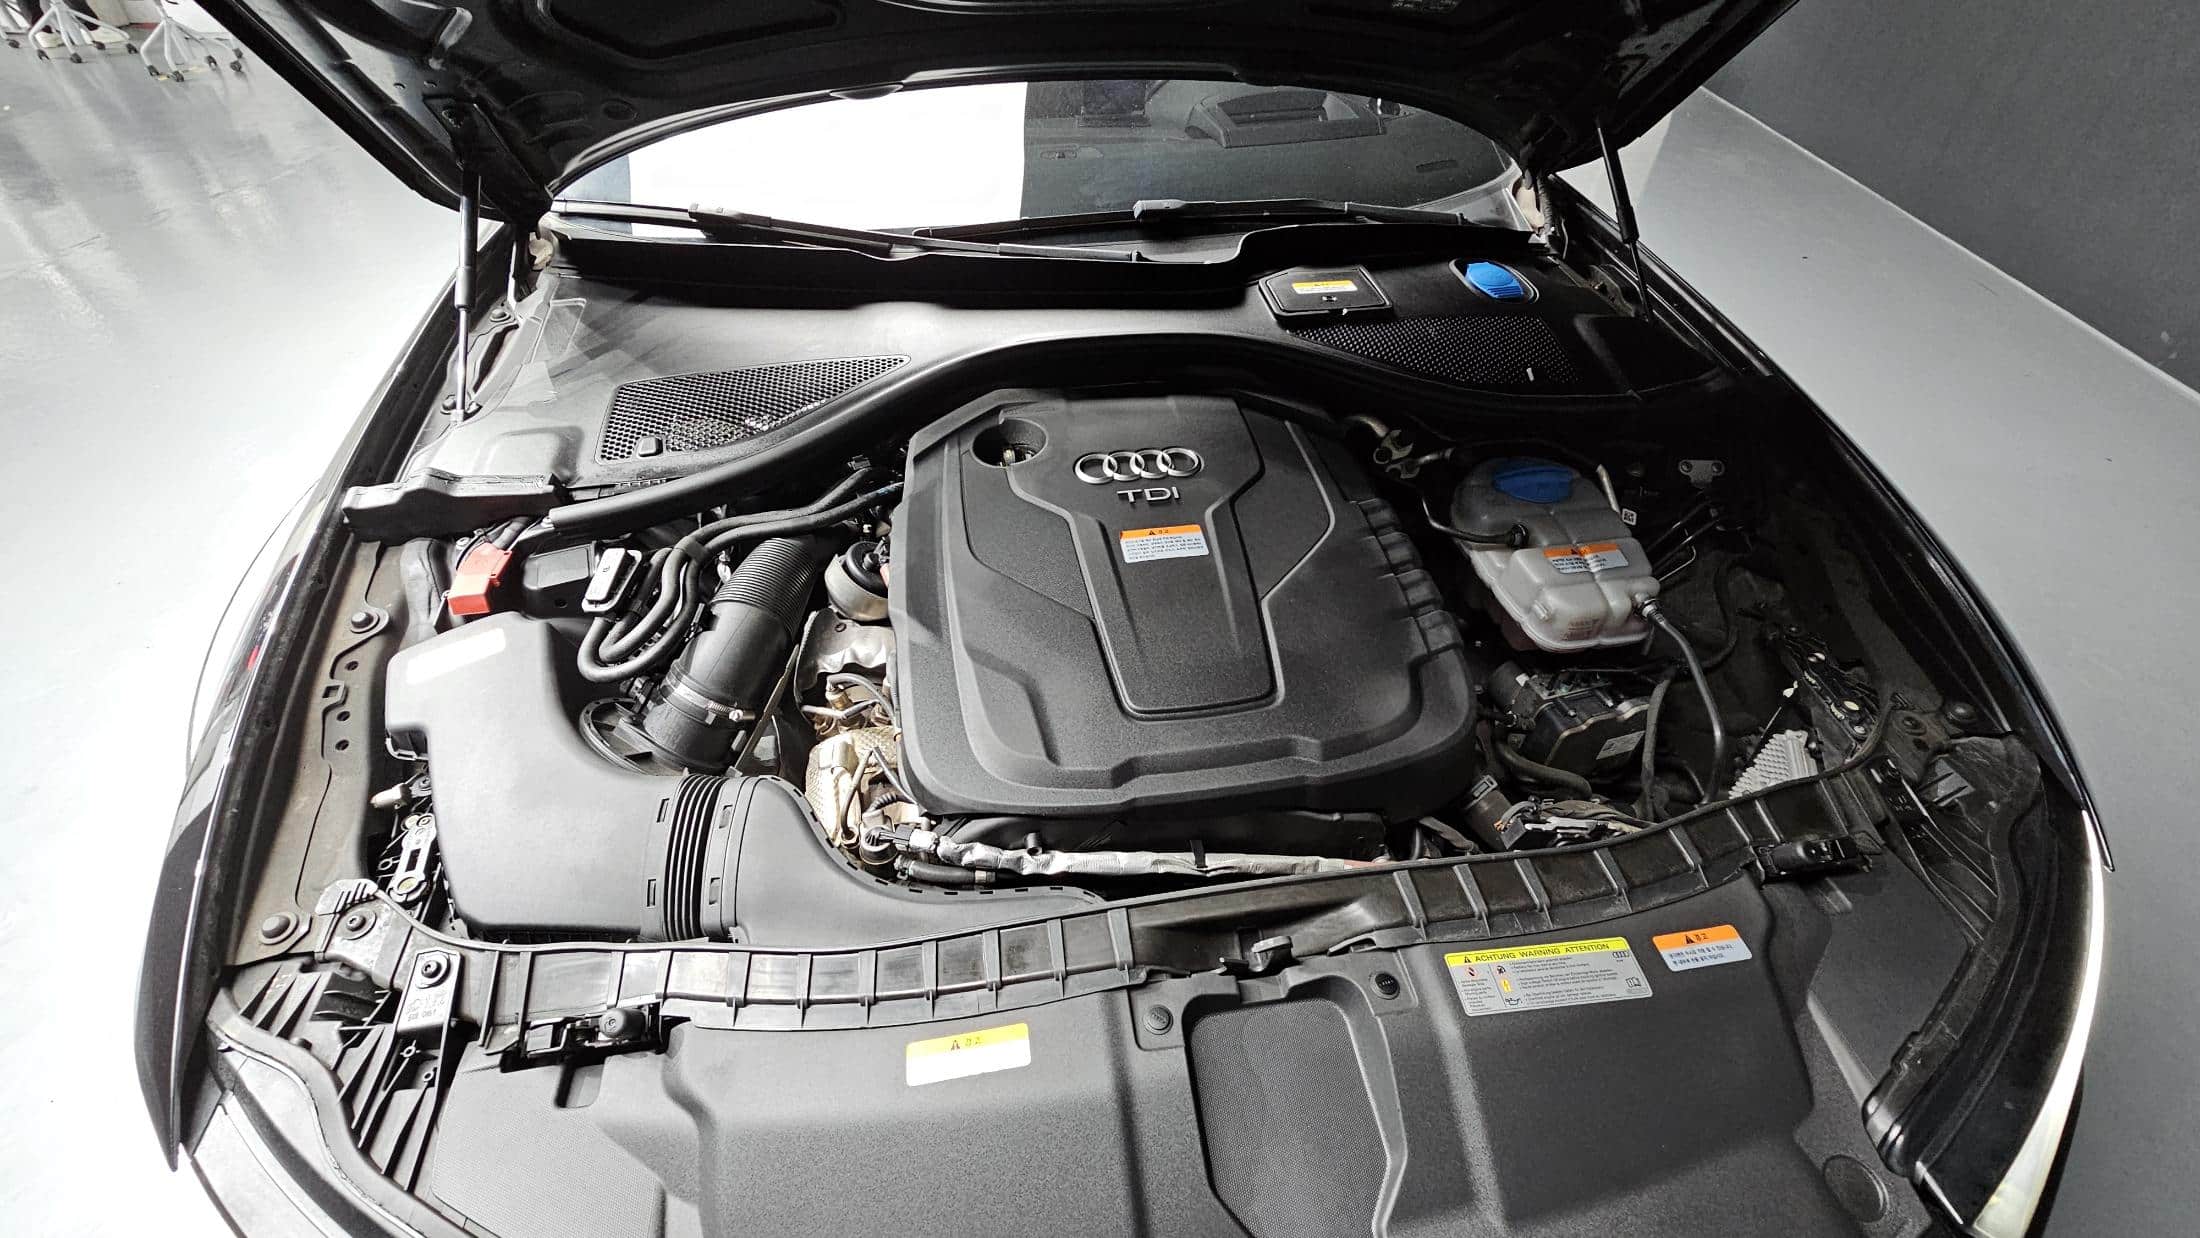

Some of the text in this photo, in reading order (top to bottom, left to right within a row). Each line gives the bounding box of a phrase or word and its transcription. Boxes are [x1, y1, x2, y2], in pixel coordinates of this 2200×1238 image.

[1116, 486, 1180, 503] TDI
[1475, 943, 1610, 962] ACHTUNG WARNING ATTENTION
